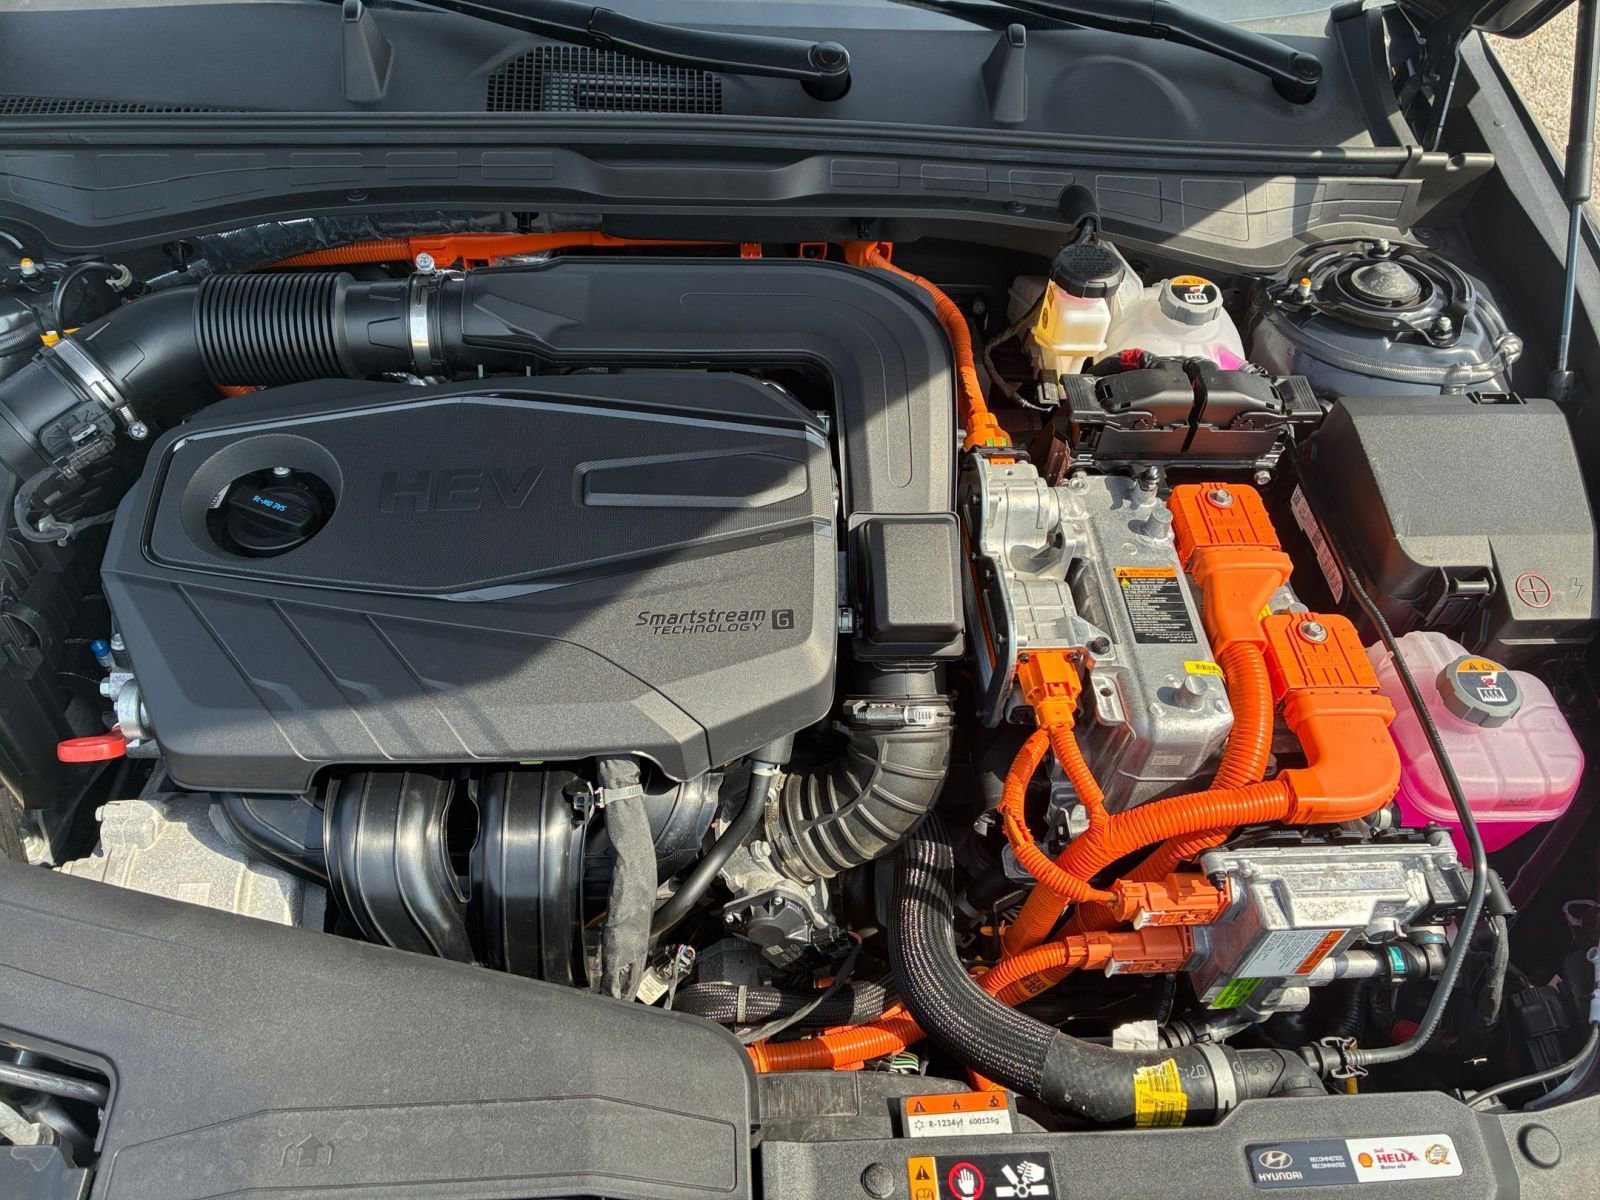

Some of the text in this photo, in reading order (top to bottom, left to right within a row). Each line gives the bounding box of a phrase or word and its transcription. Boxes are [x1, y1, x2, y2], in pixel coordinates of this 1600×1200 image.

[380, 466, 546, 513] HEV
[271, 500, 288, 512] SAE
[635, 608, 767, 626] Smartstream
[652, 622, 763, 635] TECHNOLOGY
[1376, 1151, 1417, 1163] HELIX
[1258, 1170, 1303, 1182] HYUNDAI
